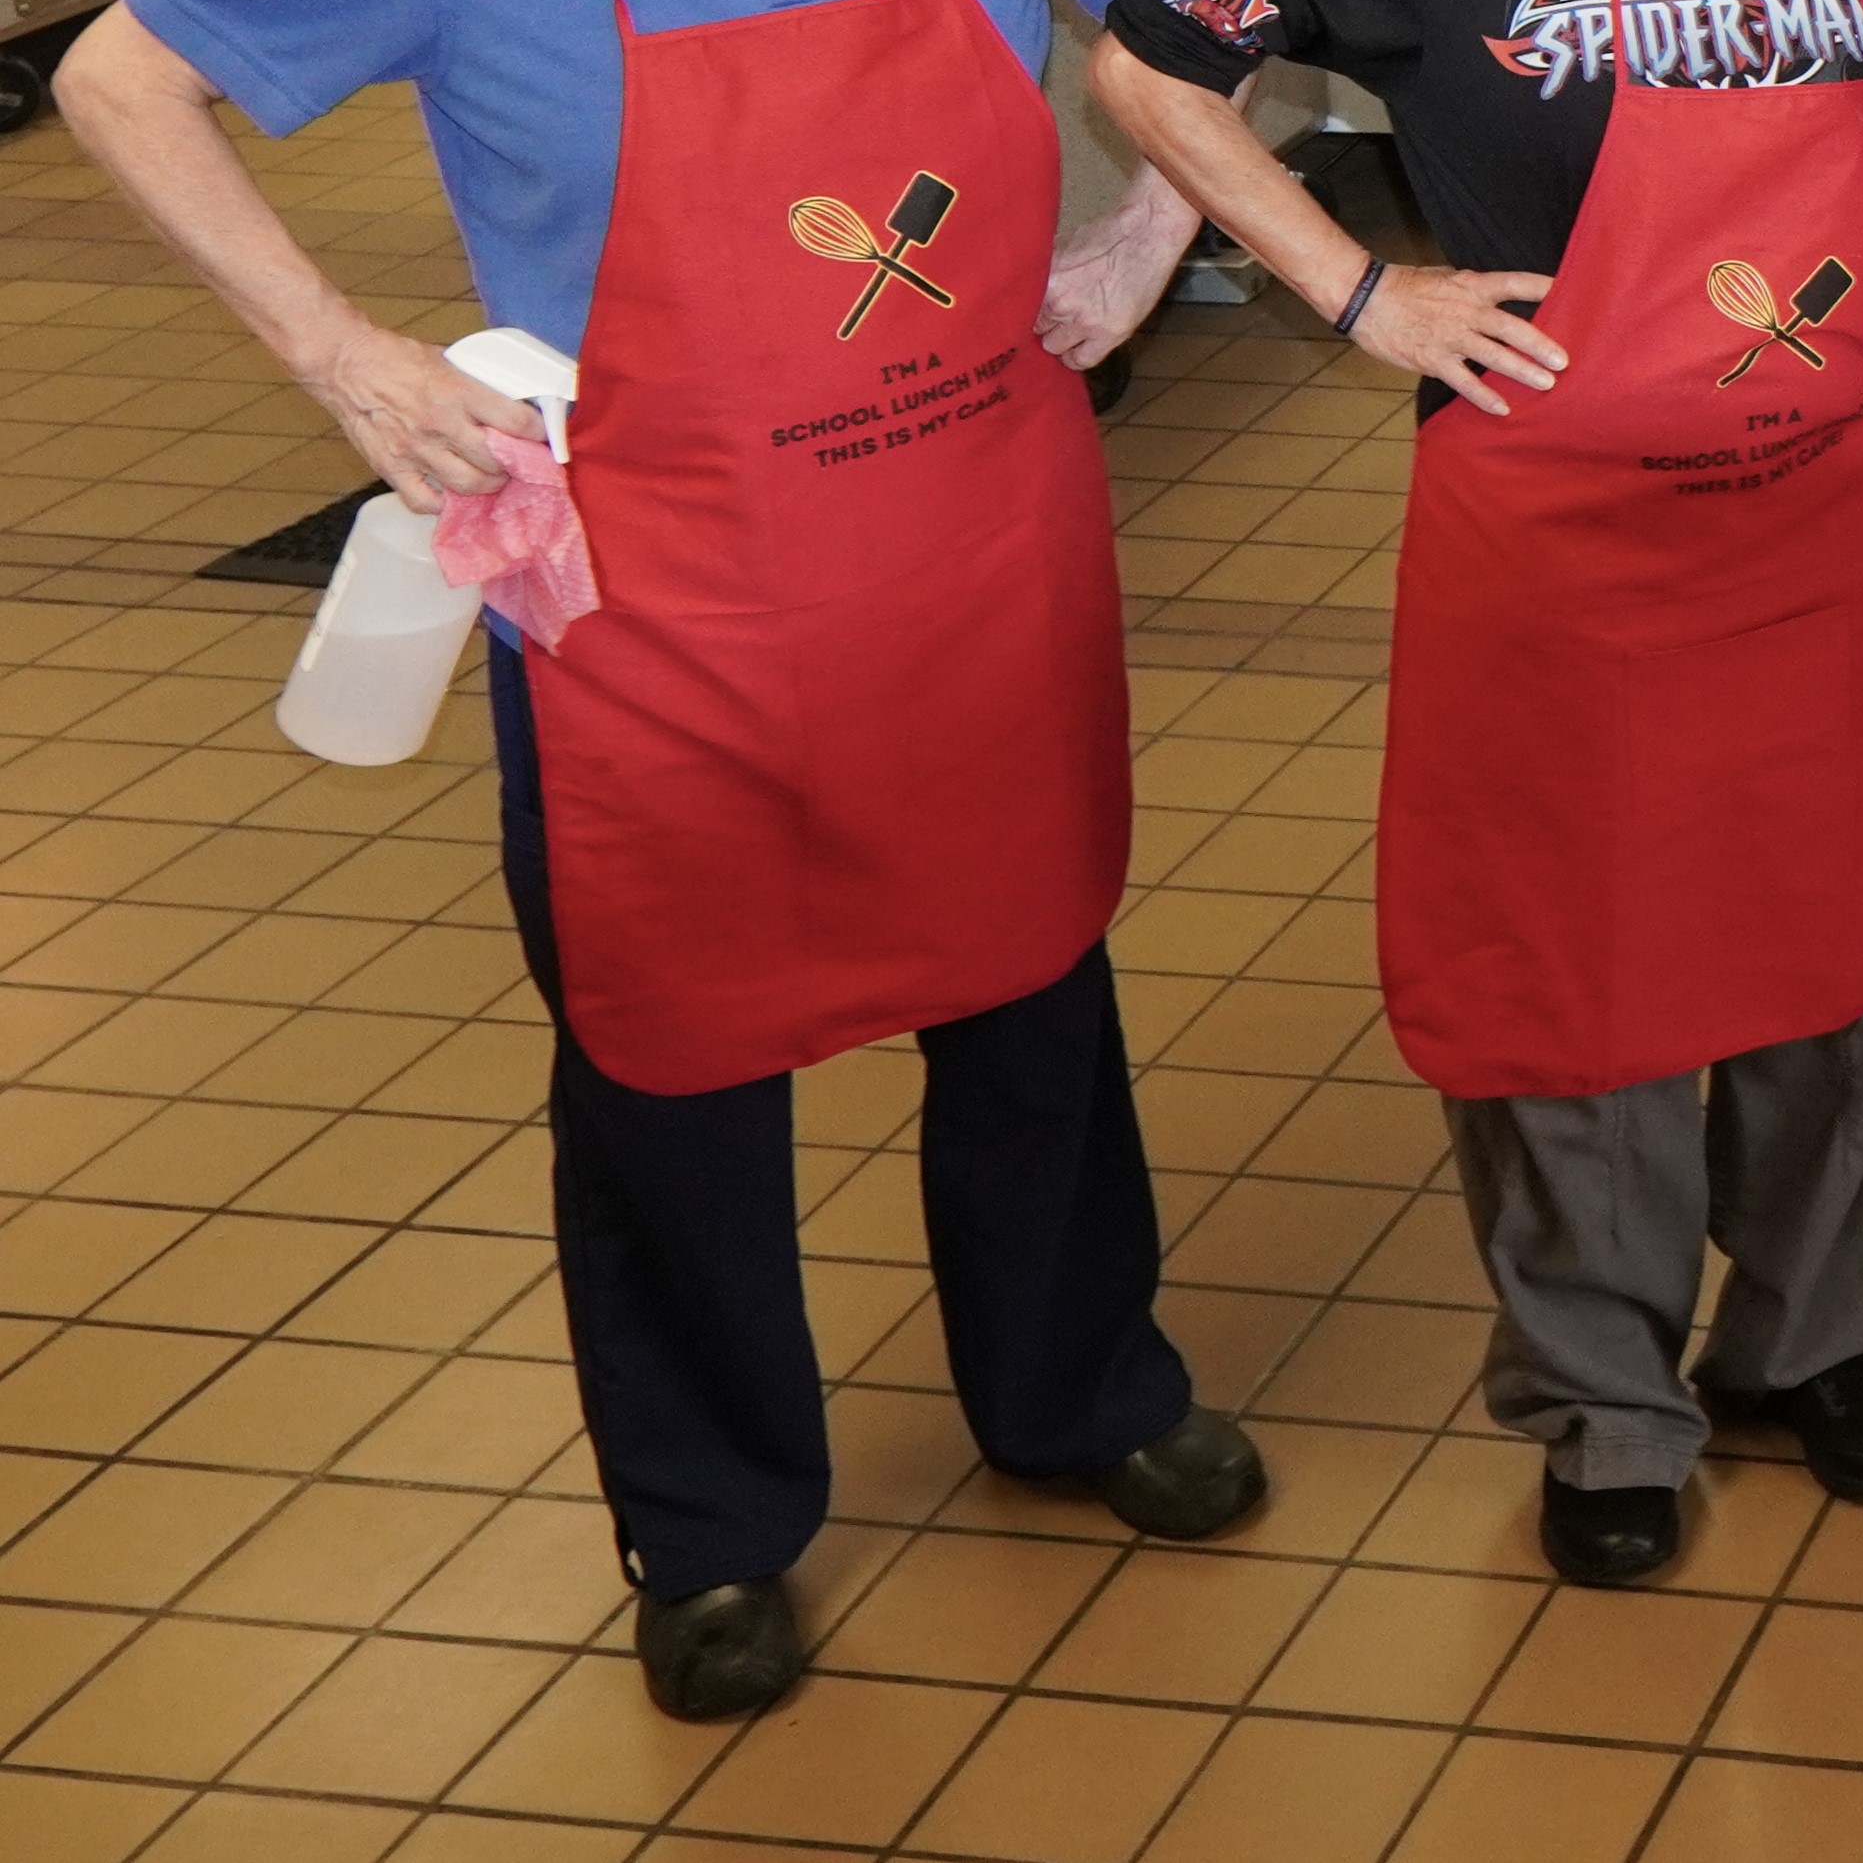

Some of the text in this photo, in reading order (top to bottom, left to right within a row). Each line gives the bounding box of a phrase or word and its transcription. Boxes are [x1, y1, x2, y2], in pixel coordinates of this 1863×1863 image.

[880, 352, 942, 385] I'M A
[771, 405, 885, 447] SCHOOL
[891, 372, 970, 415] LUNCH
[1746, 412, 1780, 431] I'M
[1787, 407, 1802, 424] A
[815, 437, 878, 468] THIS
[885, 426, 912, 449] IS
[918, 410, 951, 438] MY
[1641, 448, 1743, 471] SCHOOL
[1675, 478, 1731, 495] THIS
[1738, 473, 1763, 491] IS
[1769, 457, 1793, 483] MY
